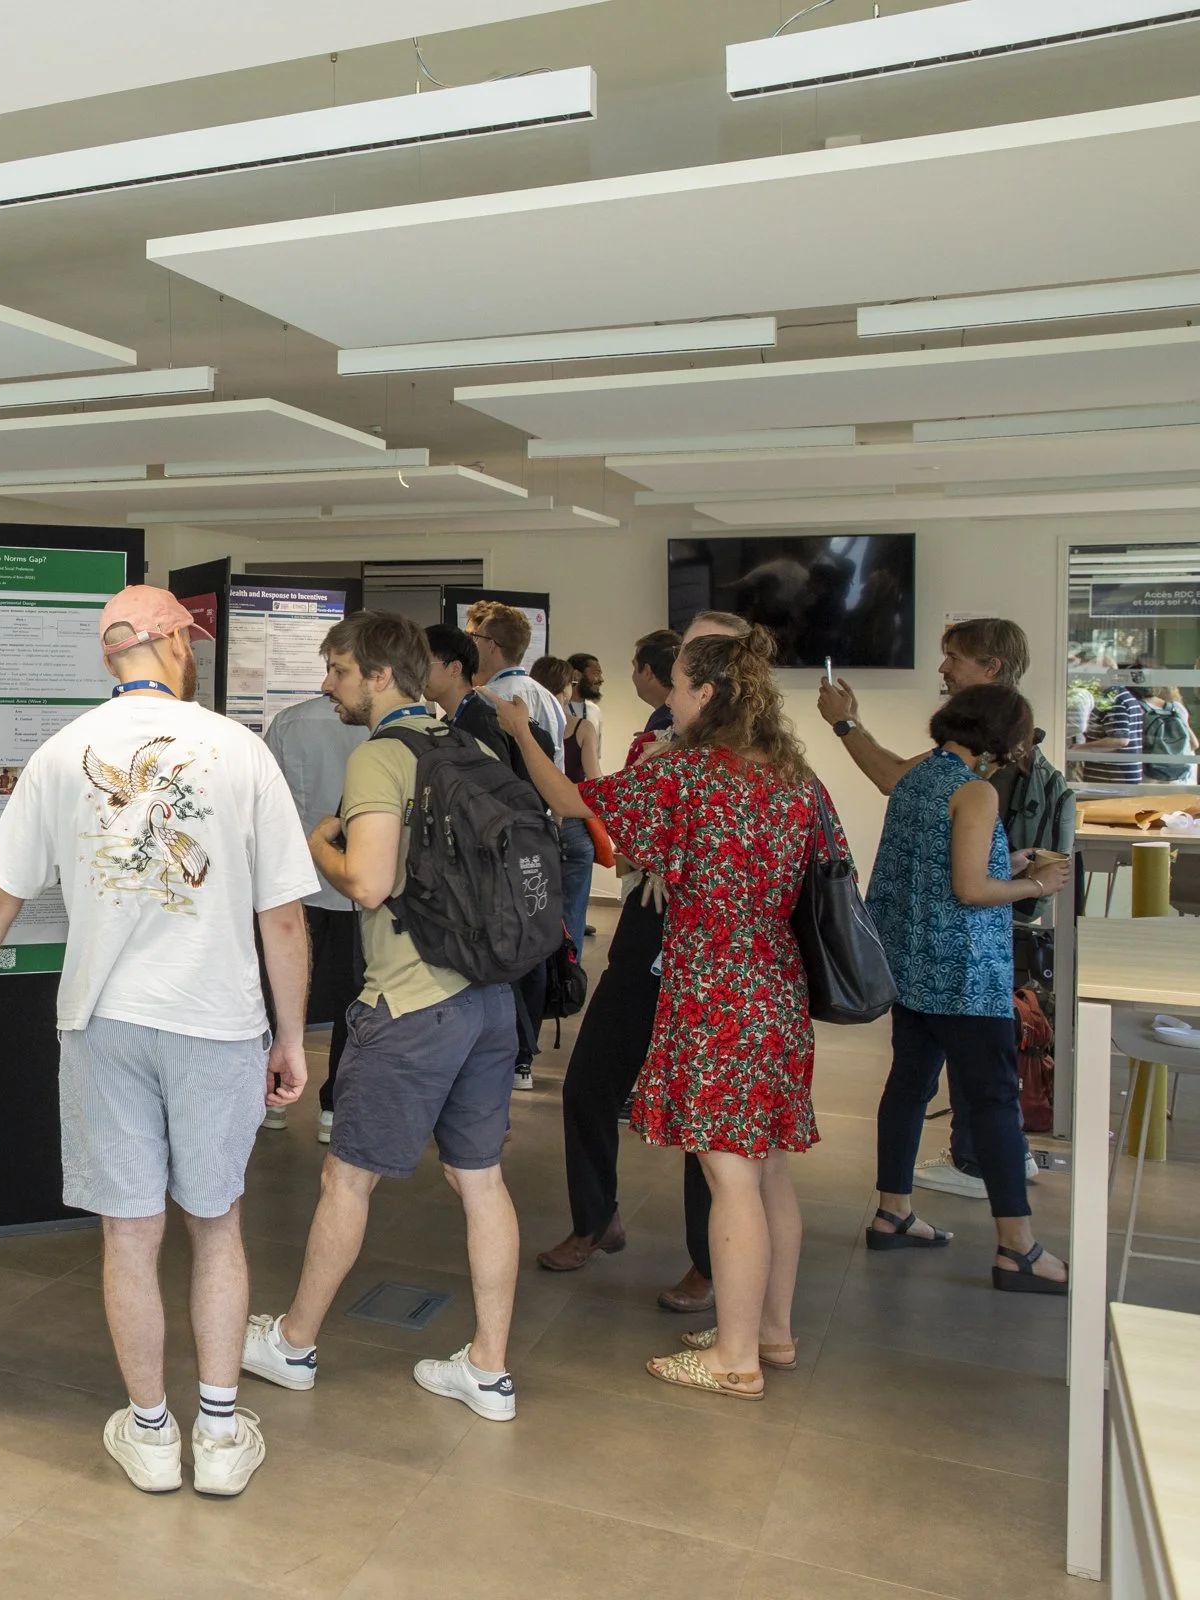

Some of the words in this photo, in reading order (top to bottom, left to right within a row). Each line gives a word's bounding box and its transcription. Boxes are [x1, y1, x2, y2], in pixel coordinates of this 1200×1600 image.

[28, 556, 47, 564] Gap?
[261, 591, 289, 599] Response
[298, 593, 328, 601] Incentives
[1144, 591, 1172, 599] Accès
